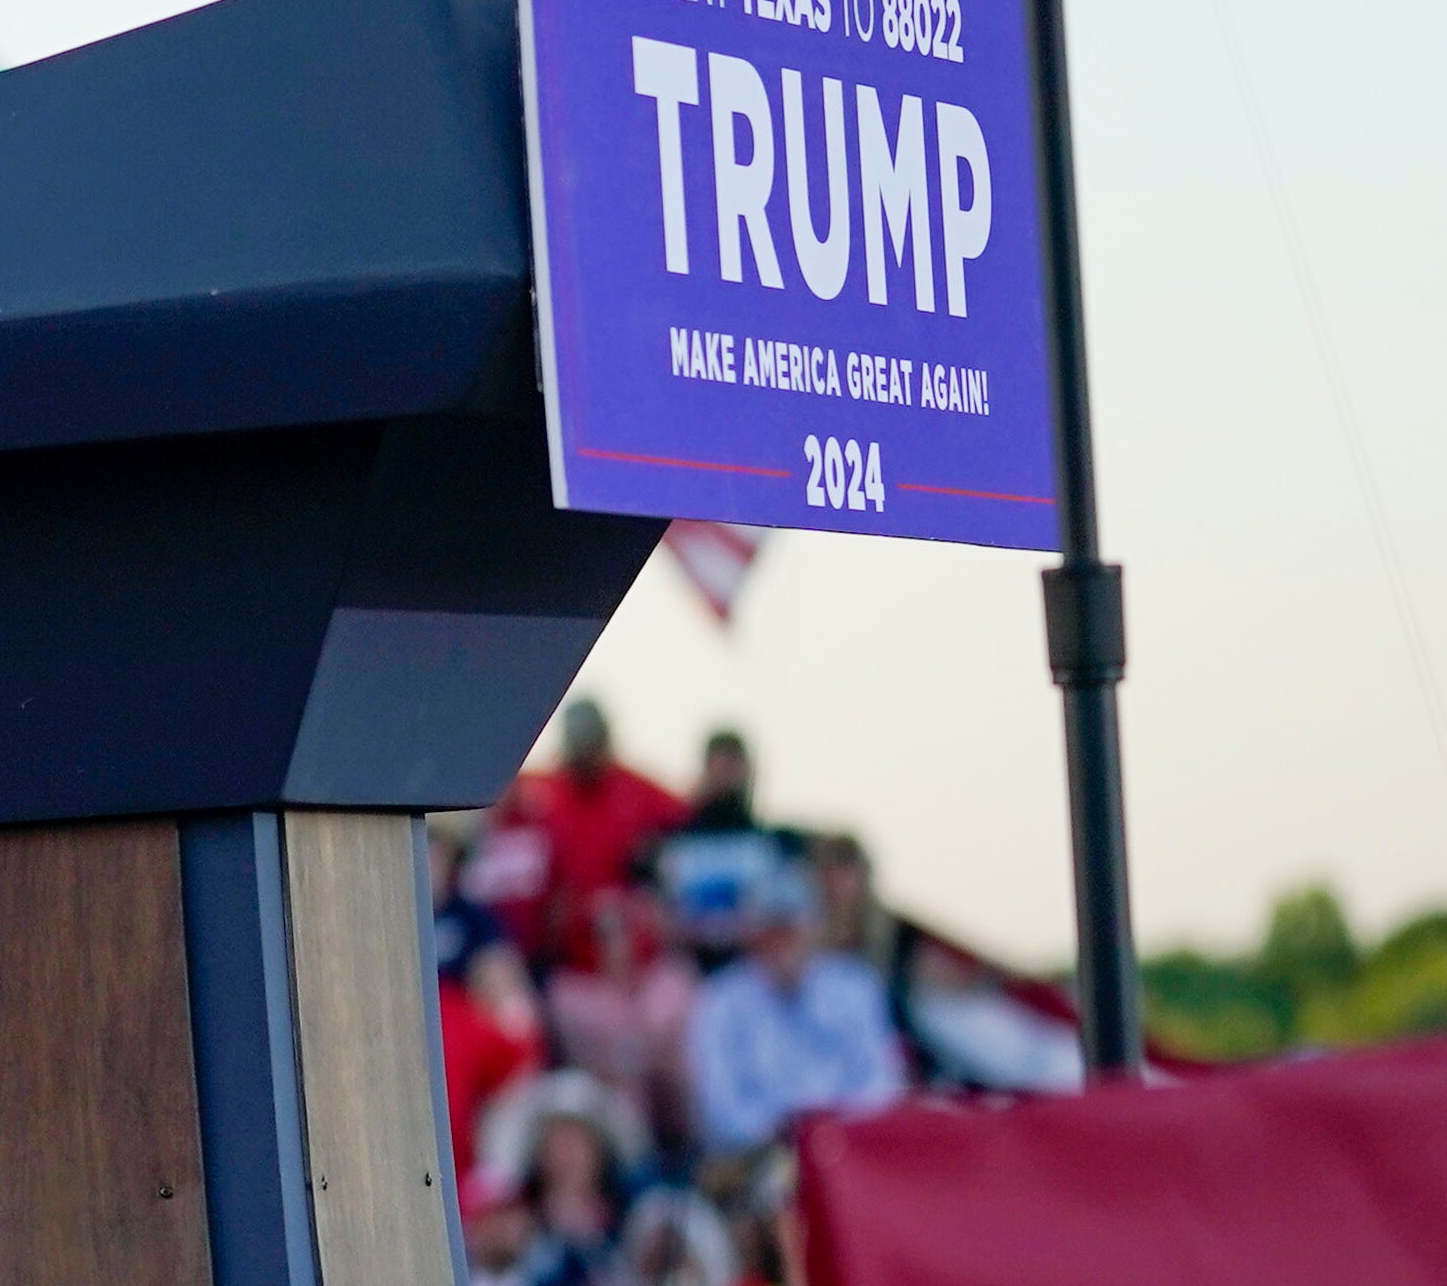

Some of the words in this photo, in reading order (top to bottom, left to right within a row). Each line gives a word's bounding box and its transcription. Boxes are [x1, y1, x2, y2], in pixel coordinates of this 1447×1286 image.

[631, 35, 992, 318] TRUMP
[669, 326, 737, 384] MAKE
[743, 337, 842, 397] AMERICA
[846, 351, 913, 406] GREAT
[920, 362, 989, 415] AGAIN!
[803, 434, 886, 513] 2024
